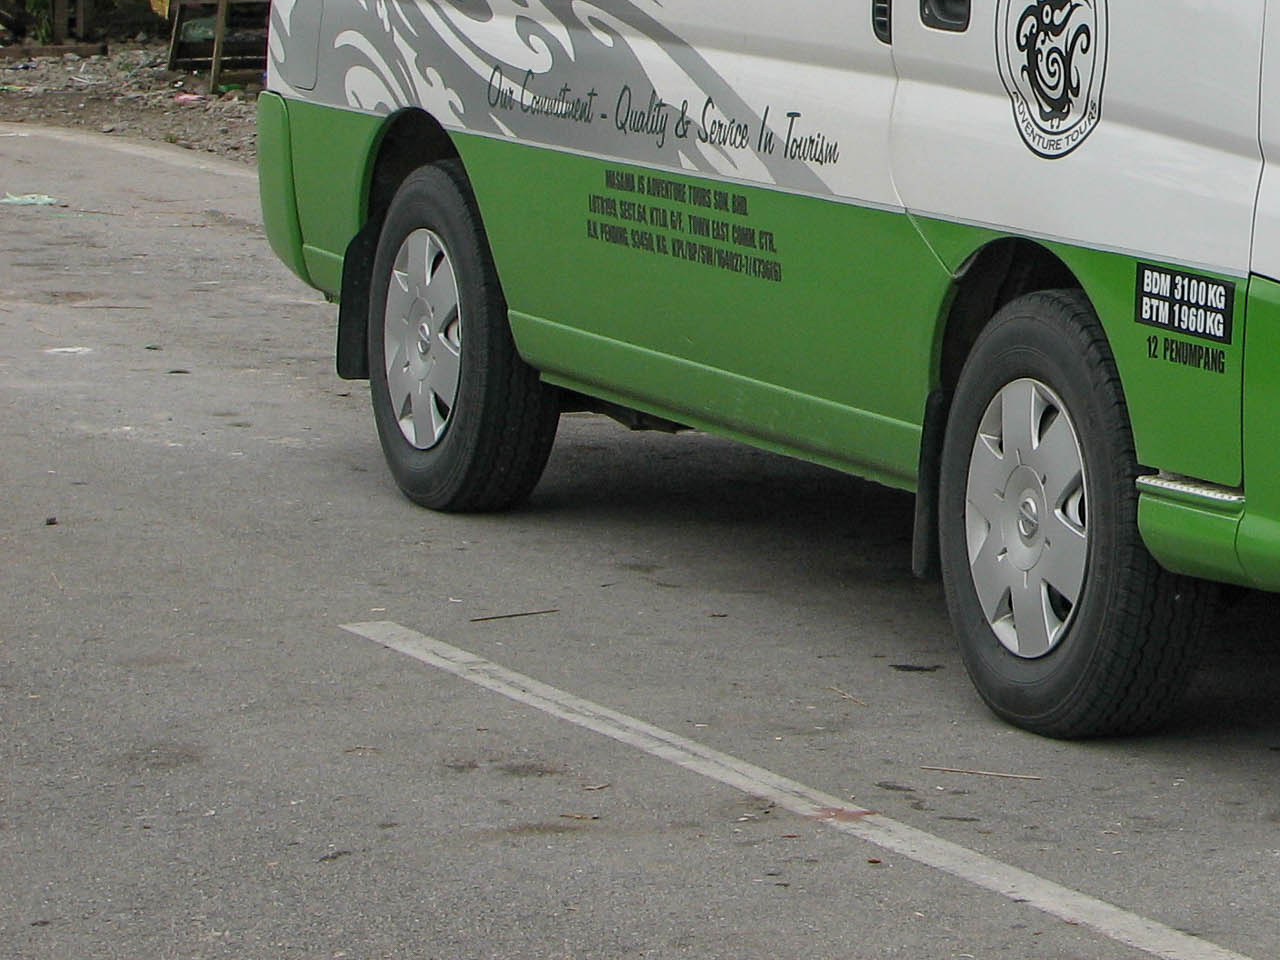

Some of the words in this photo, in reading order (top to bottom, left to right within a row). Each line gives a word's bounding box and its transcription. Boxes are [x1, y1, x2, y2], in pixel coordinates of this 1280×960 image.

[488, 65, 514, 110] Our
[616, 85, 668, 148] Quality
[675, 99, 691, 139] &
[697, 96, 749, 149] Service
[758, 105, 775, 155] In
[784, 112, 840, 166] Tourism
[1012, 90, 1062, 150] ADVENTURE
[1063, 100, 1097, 147] TOURS
[1143, 269, 1171, 297] BDM
[1174, 275, 1226, 310] 3100KG
[1142, 296, 1169, 325] BTM
[1173, 303, 1224, 337] 1960KG
[1147, 335, 1158, 359] 12
[1163, 337, 1225, 374] PENUMPANG
